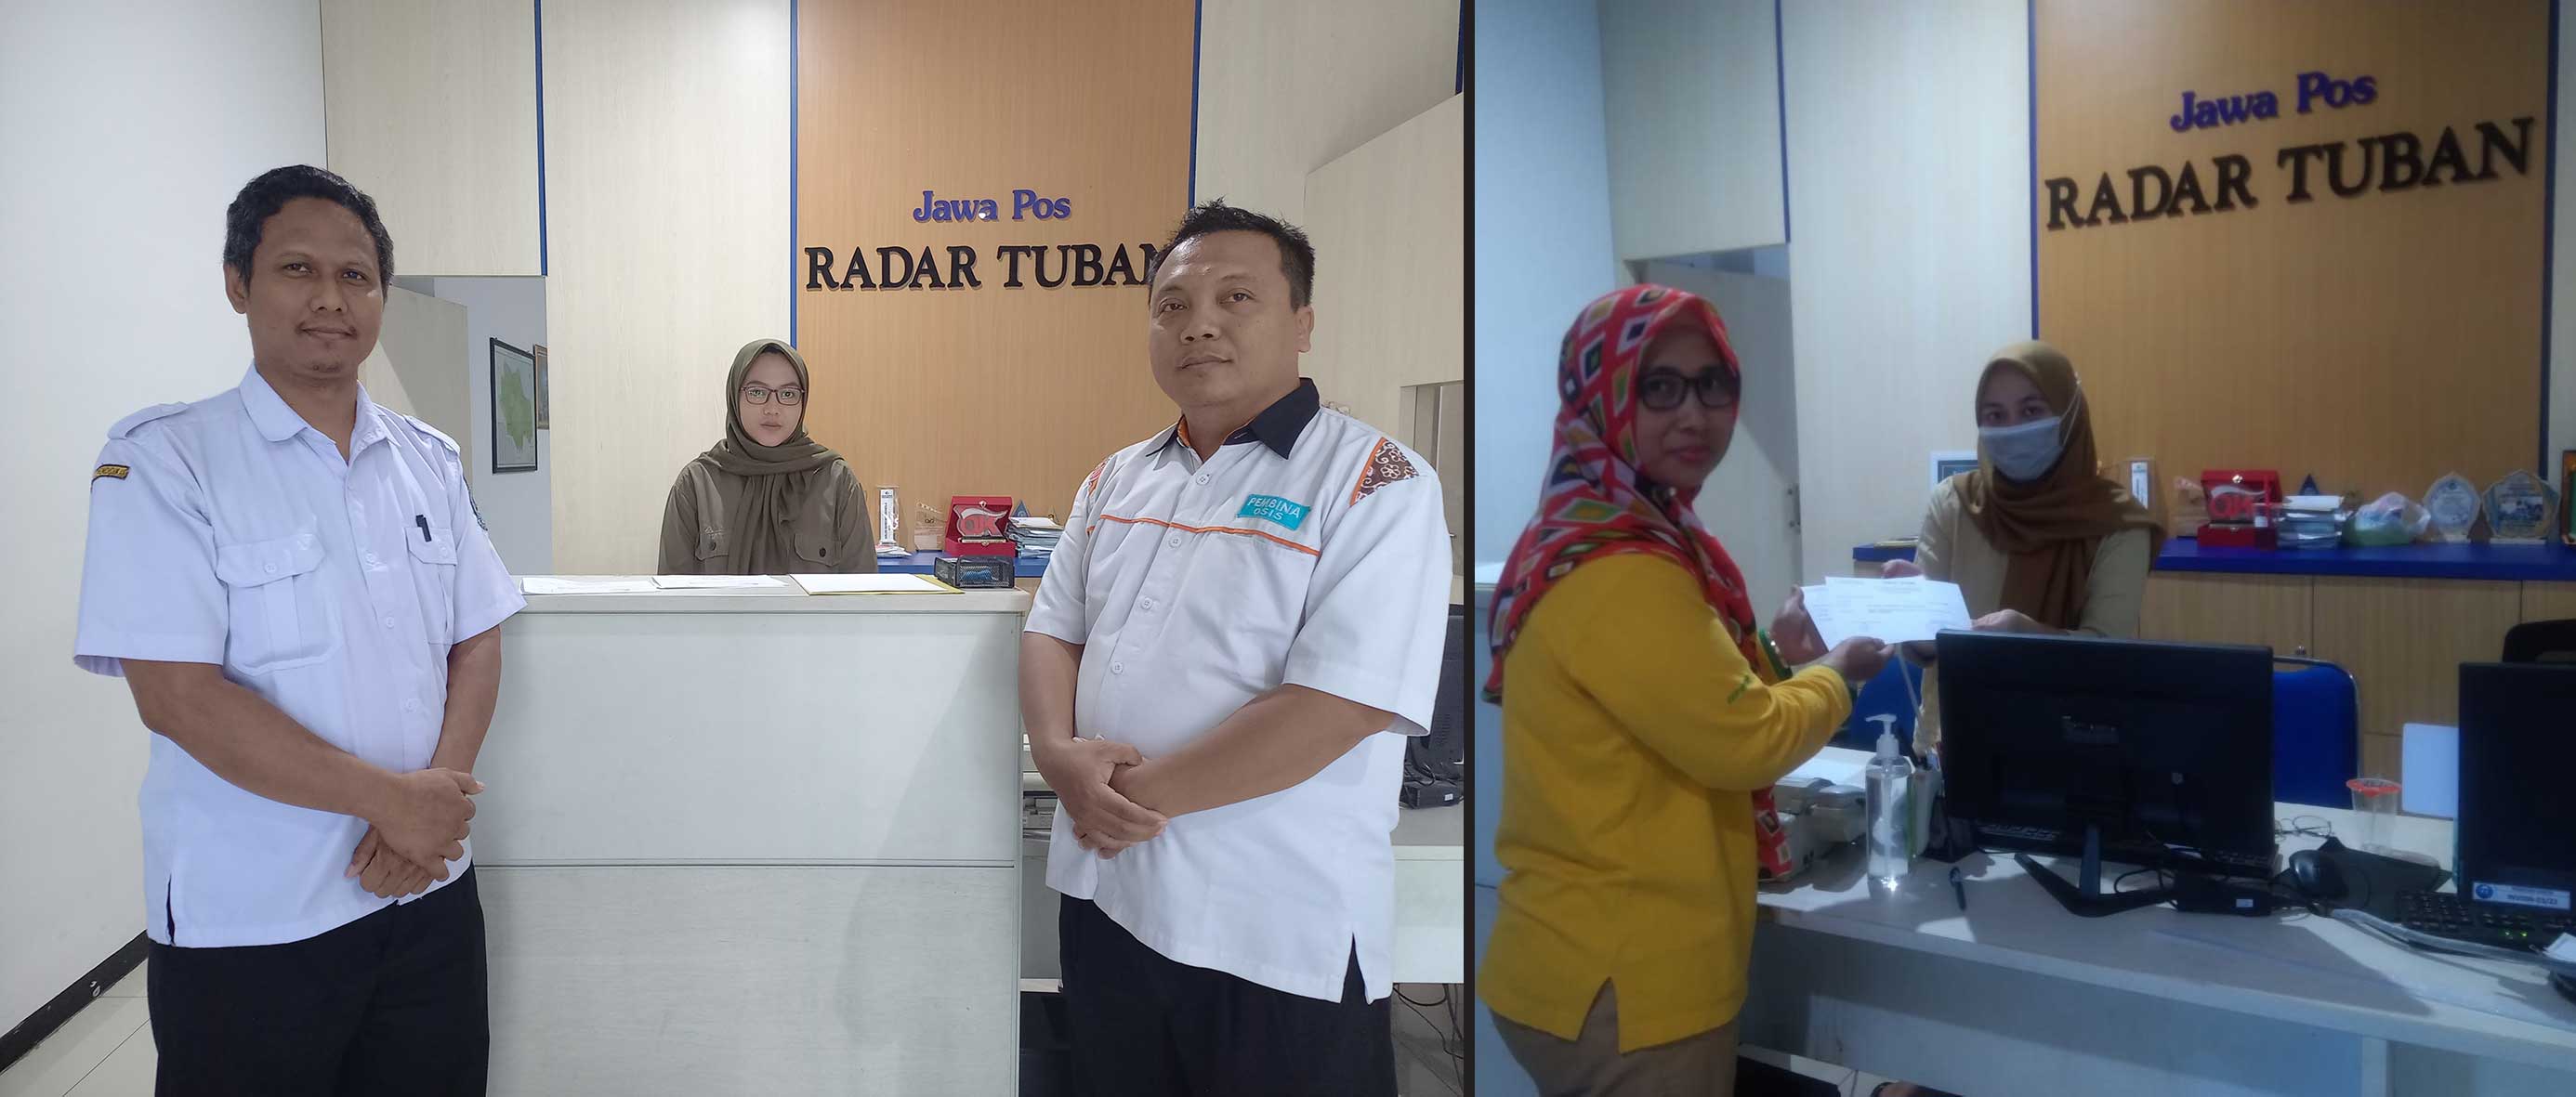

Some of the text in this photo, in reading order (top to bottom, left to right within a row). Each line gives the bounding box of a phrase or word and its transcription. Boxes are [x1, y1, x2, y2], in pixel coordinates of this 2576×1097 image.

[2170, 72, 2377, 132] Jawa Pos
[2045, 117, 2534, 230] RADAR TUBAN
[913, 189, 1071, 222] Jawa Pos
[805, 246, 981, 291] RADAR
[1246, 497, 1301, 518] PEMBINA
[1253, 507, 1283, 520] OSIS
